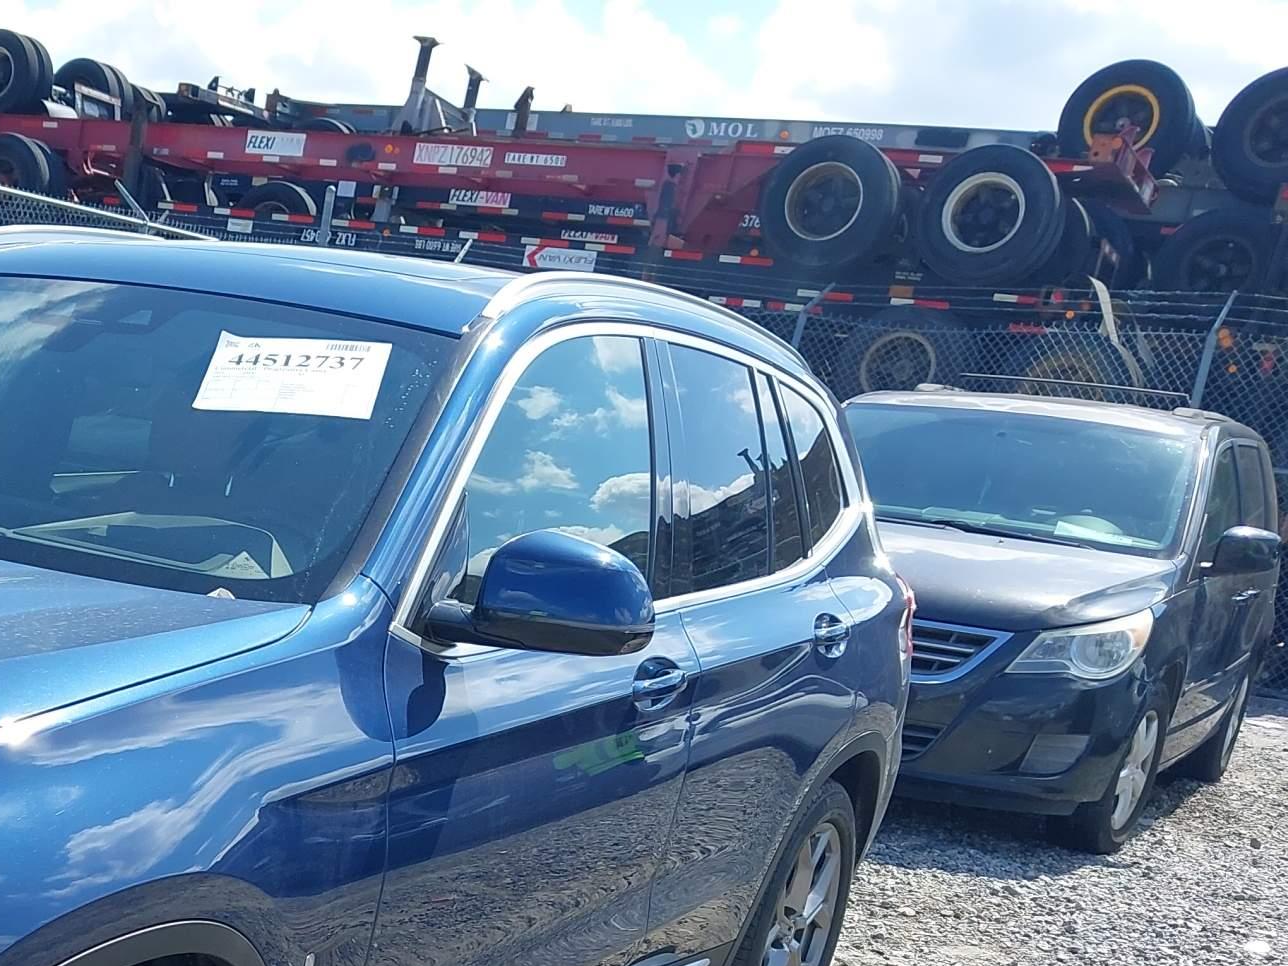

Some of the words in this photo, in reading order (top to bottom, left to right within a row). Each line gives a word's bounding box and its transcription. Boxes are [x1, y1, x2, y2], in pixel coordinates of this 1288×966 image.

[709, 121, 758, 138] MOL
[247, 135, 276, 150] FLEXI
[227, 352, 365, 371] 44512737
